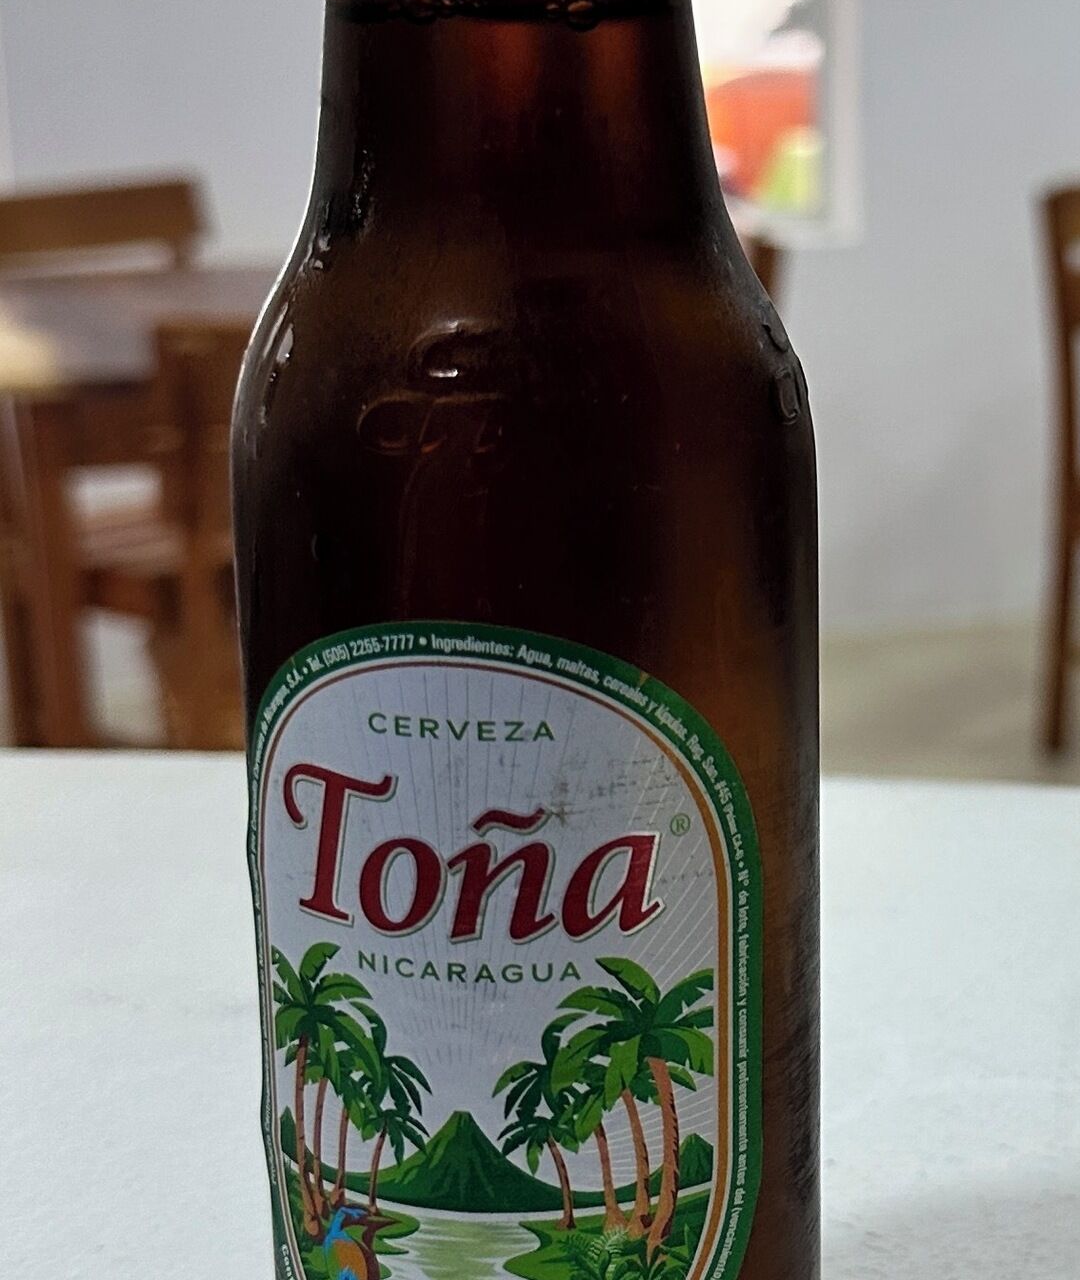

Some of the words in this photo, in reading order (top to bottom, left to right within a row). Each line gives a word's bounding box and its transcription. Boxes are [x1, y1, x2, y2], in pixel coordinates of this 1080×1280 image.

[431, 633, 513, 656] Ingredientes:
[517, 644, 553, 668] Agua,
[368, 713, 555, 742] CERVEZA
[283, 762, 666, 945] Toña
[358, 949, 582, 984] NICARAGUA
